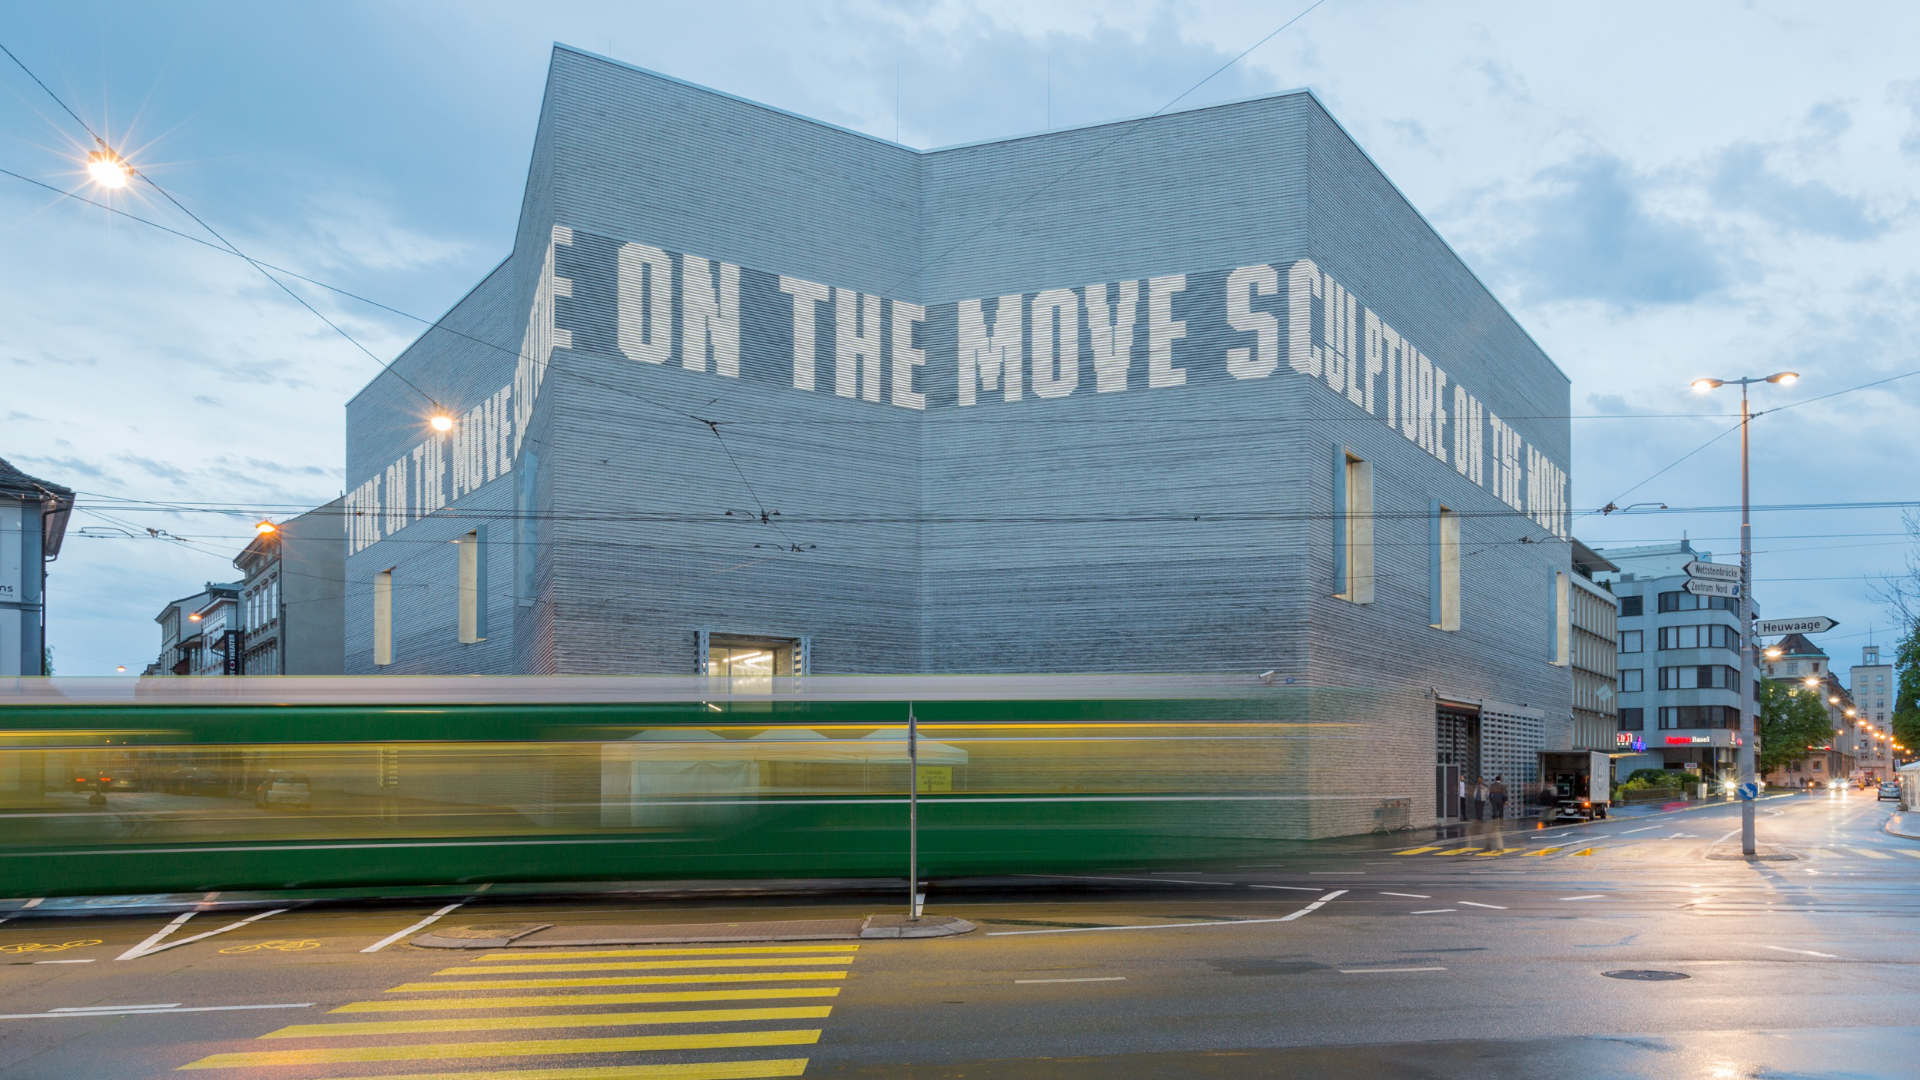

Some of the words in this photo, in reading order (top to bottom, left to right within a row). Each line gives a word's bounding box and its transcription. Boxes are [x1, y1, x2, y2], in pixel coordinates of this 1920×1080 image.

[386, 455, 407, 537] ON
[413, 428, 446, 521] THE
[452, 384, 511, 501] MOVE
[617, 241, 740, 378] ON
[779, 275, 926, 410] THE
[958, 274, 1187, 406] MOVE
[1226, 259, 1447, 462] SCULPTURE
[1454, 384, 1483, 486] ON
[1490, 411, 1522, 513] THE
[1527, 443, 1567, 543] MOVE
[1694, 564, 1738, 578] Wettsteinbrücke
[1691, 581, 1714, 593] Zentrum
[1715, 583, 1728, 594] Nord
[1763, 620, 1821, 633] Heuwaage
[228, 633, 236, 660] THEATER
[1692, 736, 1710, 744] Basel
